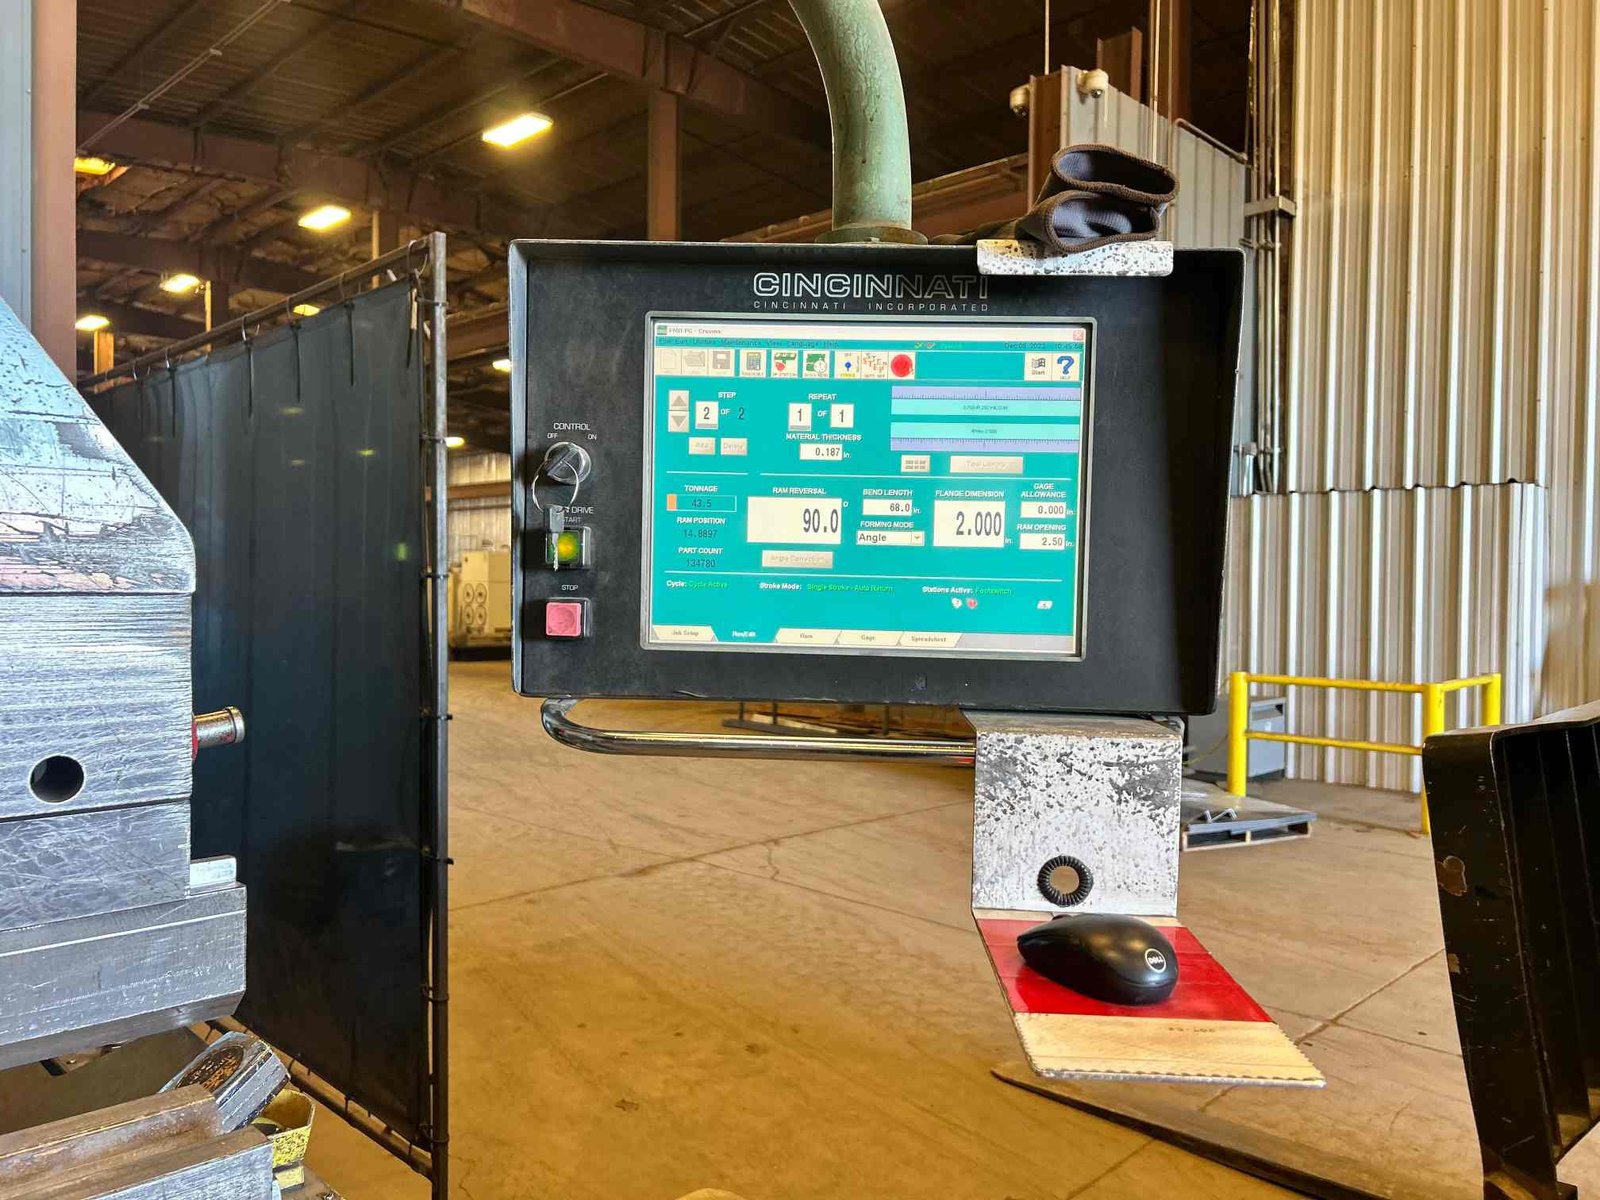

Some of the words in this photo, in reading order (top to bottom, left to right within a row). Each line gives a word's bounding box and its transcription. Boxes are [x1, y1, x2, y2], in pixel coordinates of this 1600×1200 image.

[753, 272, 988, 299] CINCINNATI
[753, 301, 847, 310] CINCINNATI
[869, 303, 988, 311] INCORPORATED
[718, 391, 737, 399] STEP
[703, 406, 711, 420] 2
[720, 408, 731, 416] OF
[738, 407, 745, 420] 2
[553, 422, 590, 431] CONTROL
[786, 433, 820, 441] MATERIAL
[815, 447, 841, 457] 0.187
[790, 487, 826, 495] REVERSAL
[964, 490, 1004, 498] DIMENSION
[691, 498, 712, 508] 43.5
[889, 503, 911, 512] 68.0
[571, 506, 594, 515] DRIVE
[1037, 505, 1064, 515] 0.000
[677, 516, 693, 524] RAM
[693, 517, 725, 525] POSITION
[803, 508, 839, 533] 90.0
[955, 511, 1002, 537] 2.000
[1017, 523, 1033, 531] RAM
[683, 528, 718, 539] 14.8897
[858, 533, 887, 543] Angle
[1041, 537, 1064, 547] 2.50
[698, 547, 723, 555] COUNT
[686, 558, 716, 568] 134780
[666, 580, 687, 588] Cycle:
[688, 580, 706, 589] Cycle
[760, 582, 781, 590] Stroke
[807, 584, 828, 592] Single
[950, 586, 973, 594] Active:
[1147, 955, 1164, 965] DELL
